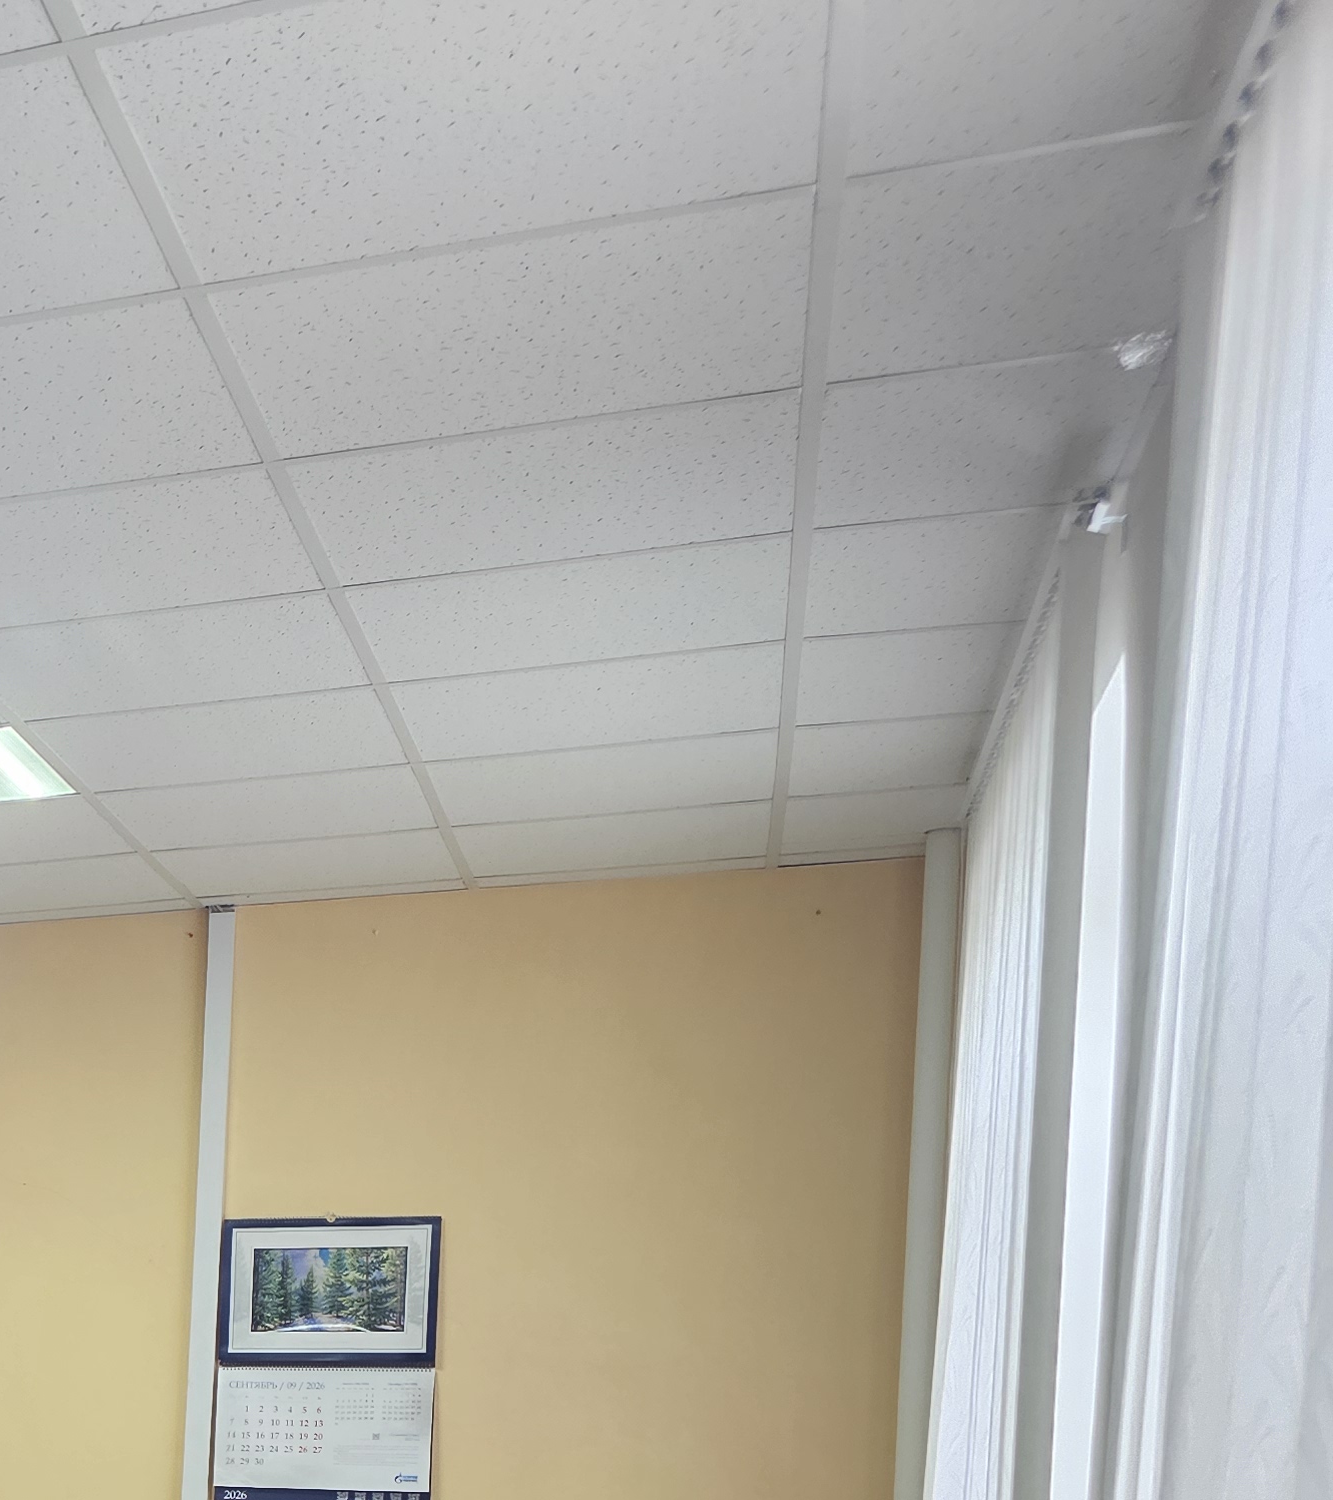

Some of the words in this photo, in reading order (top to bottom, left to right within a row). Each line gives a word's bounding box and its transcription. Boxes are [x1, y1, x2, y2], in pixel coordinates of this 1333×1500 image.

[229, 1381, 278, 1389] СЕНТЯБРЬ
[306, 1382, 325, 1390] 2026
[223, 1490, 247, 1499] 2026
